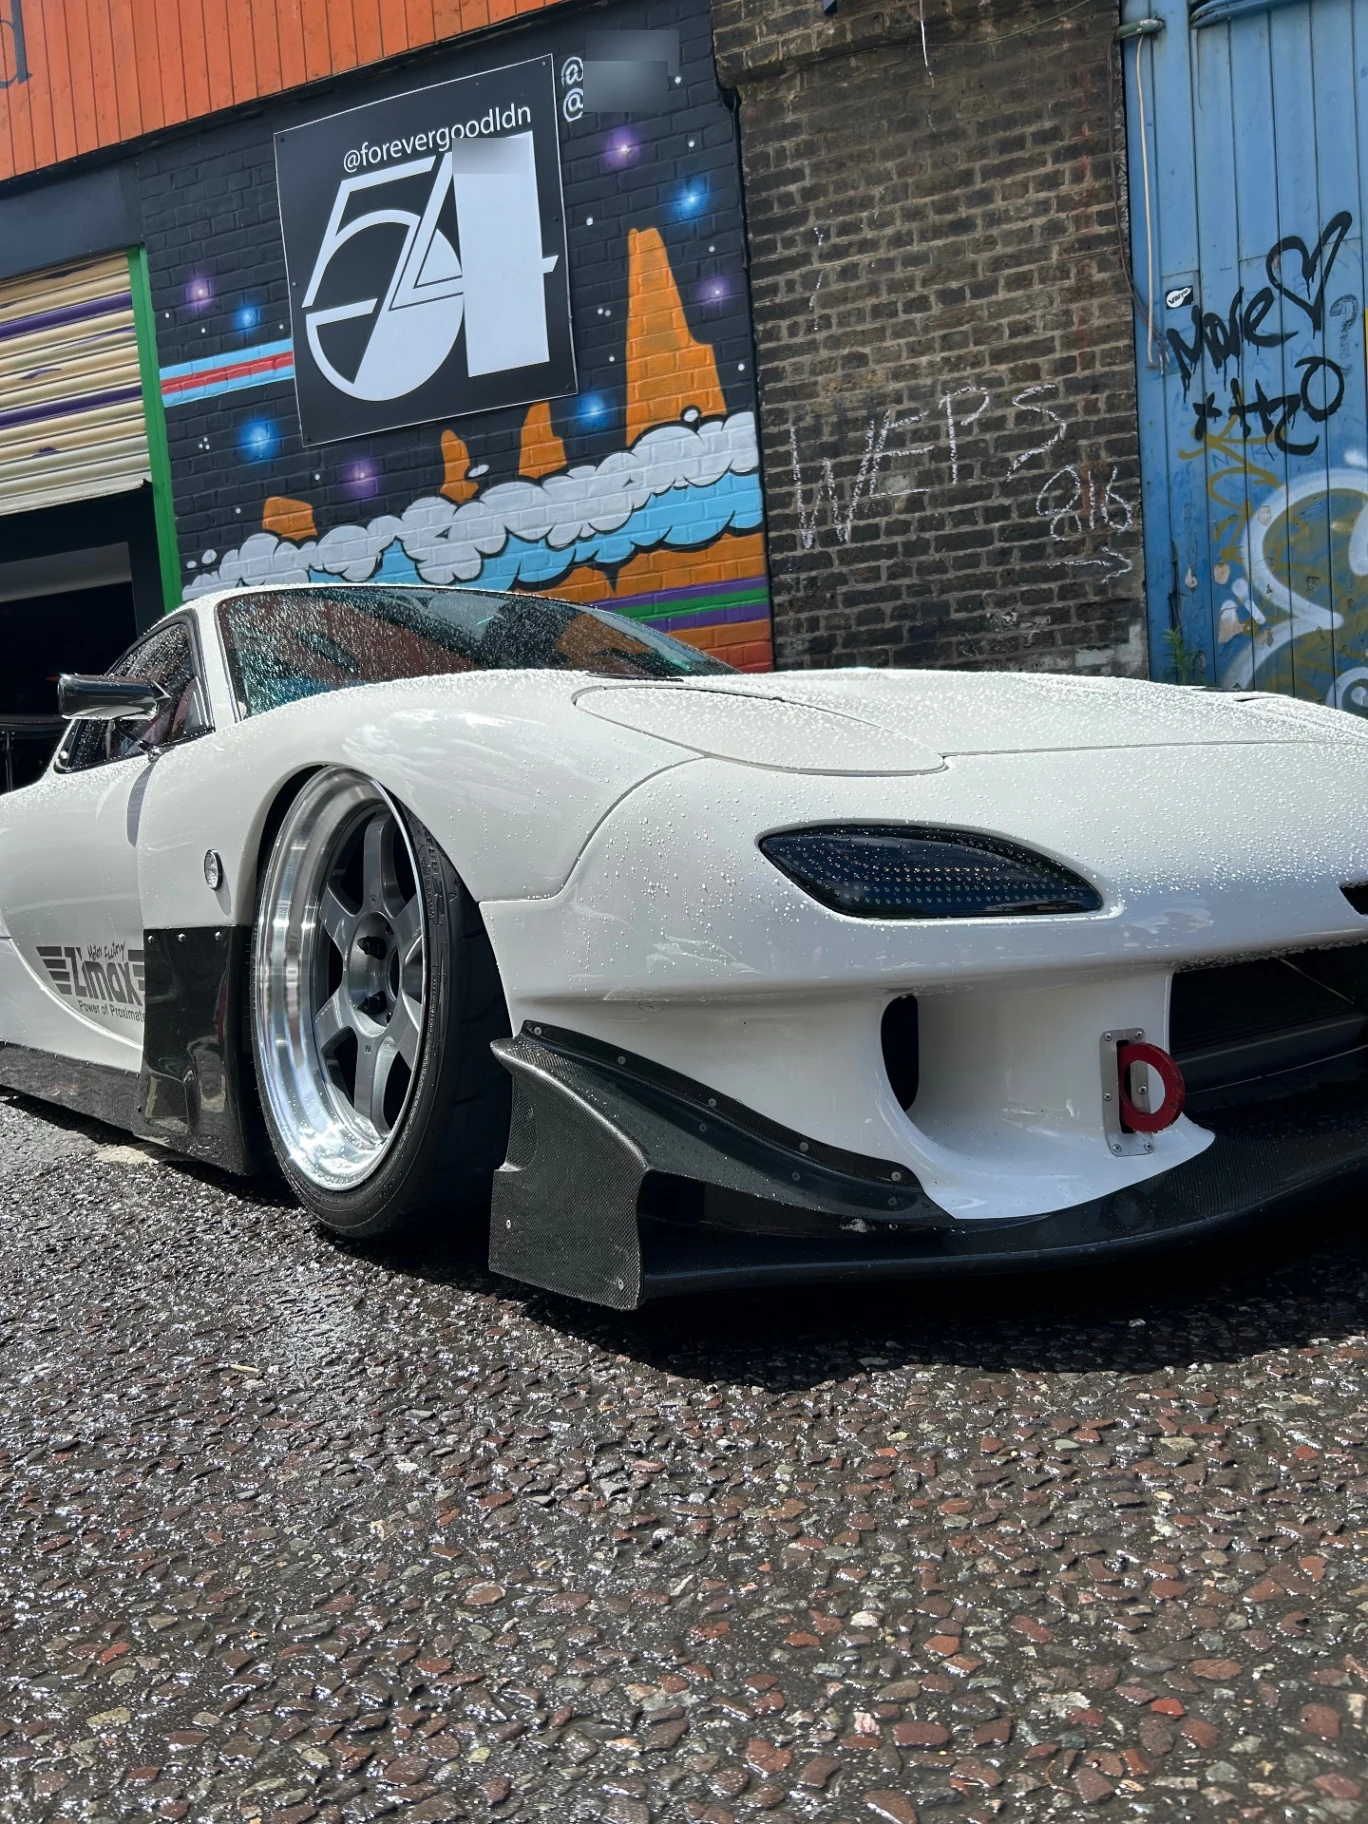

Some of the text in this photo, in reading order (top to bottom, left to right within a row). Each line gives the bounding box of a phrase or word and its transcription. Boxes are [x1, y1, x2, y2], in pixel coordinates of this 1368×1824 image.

[343, 103, 532, 173] @forevergoodldn
[78, 999, 100, 1014] Power
[101, 1003, 108, 1016] of
